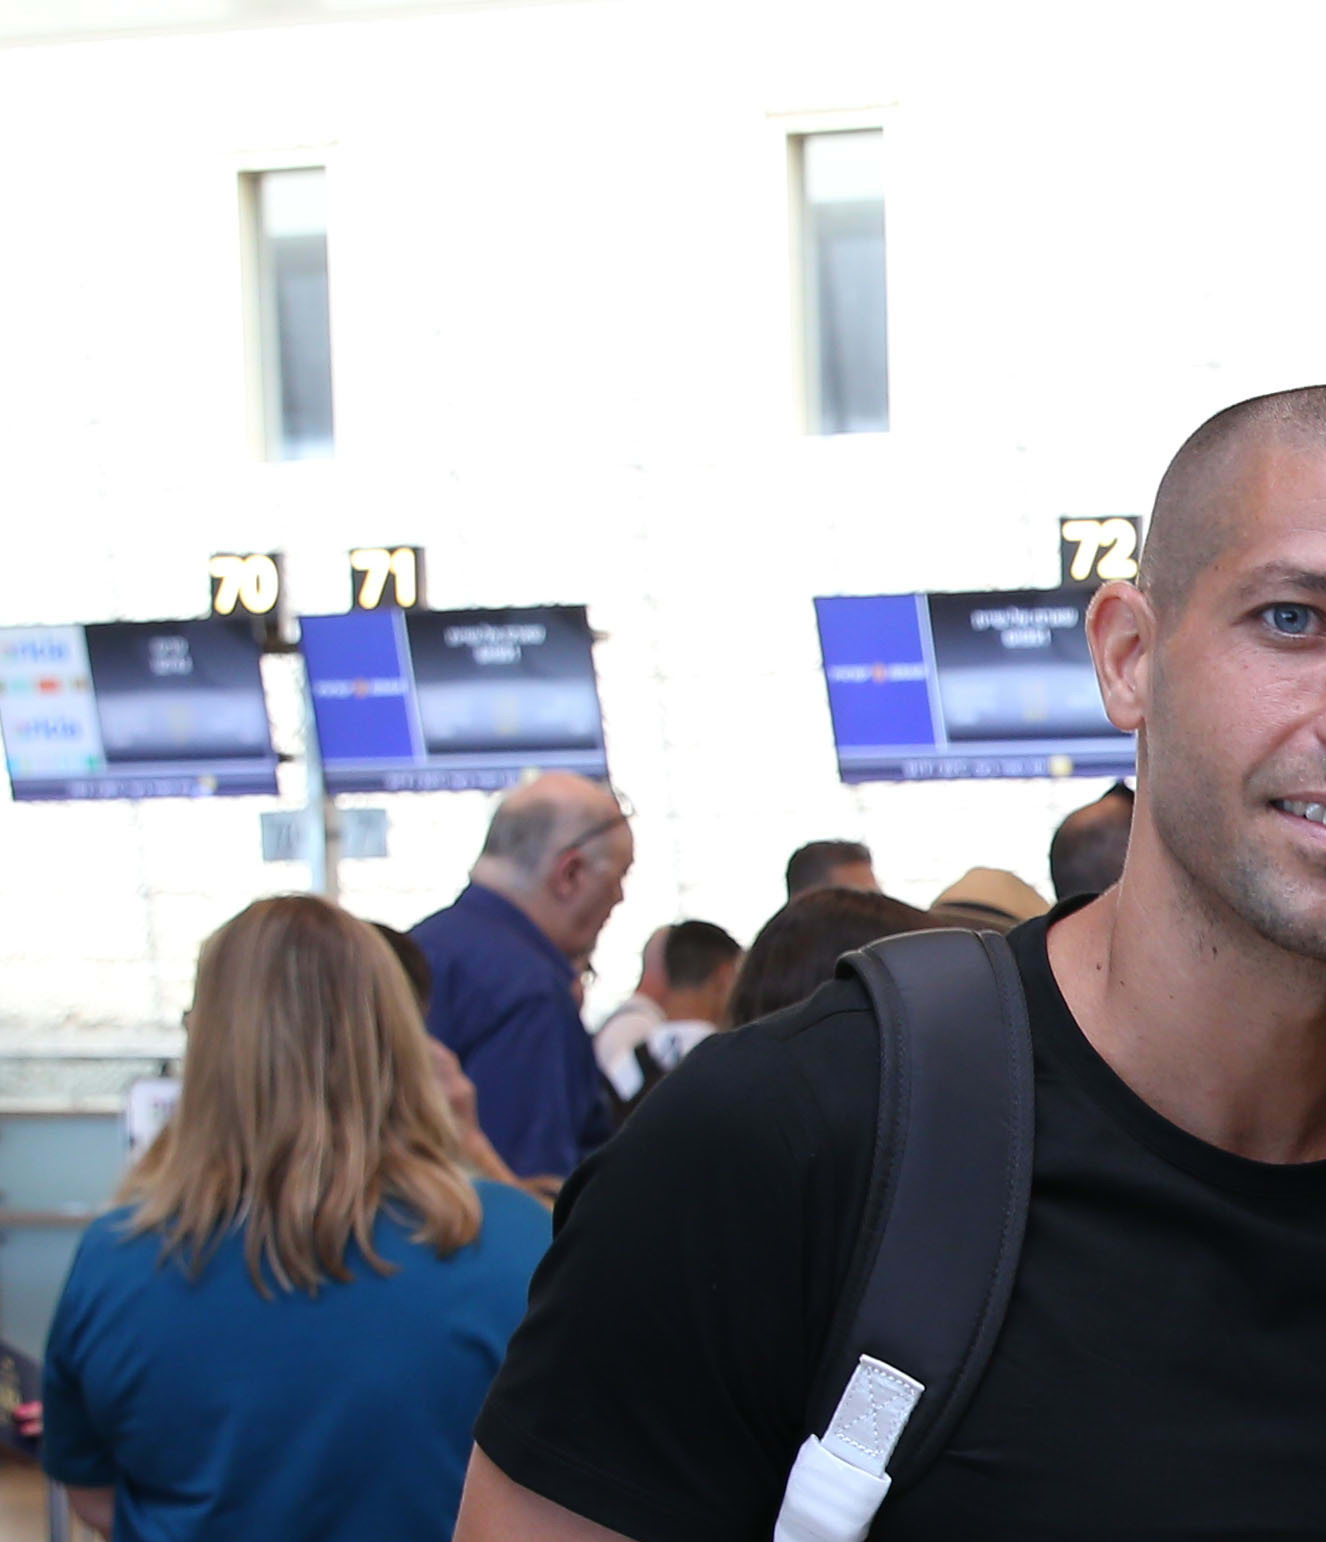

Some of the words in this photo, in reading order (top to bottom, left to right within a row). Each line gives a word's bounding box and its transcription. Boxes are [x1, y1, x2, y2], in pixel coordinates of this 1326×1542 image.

[350, 547, 416, 609] 71
[1061, 517, 1138, 581] 72
[209, 554, 279, 614] 70
